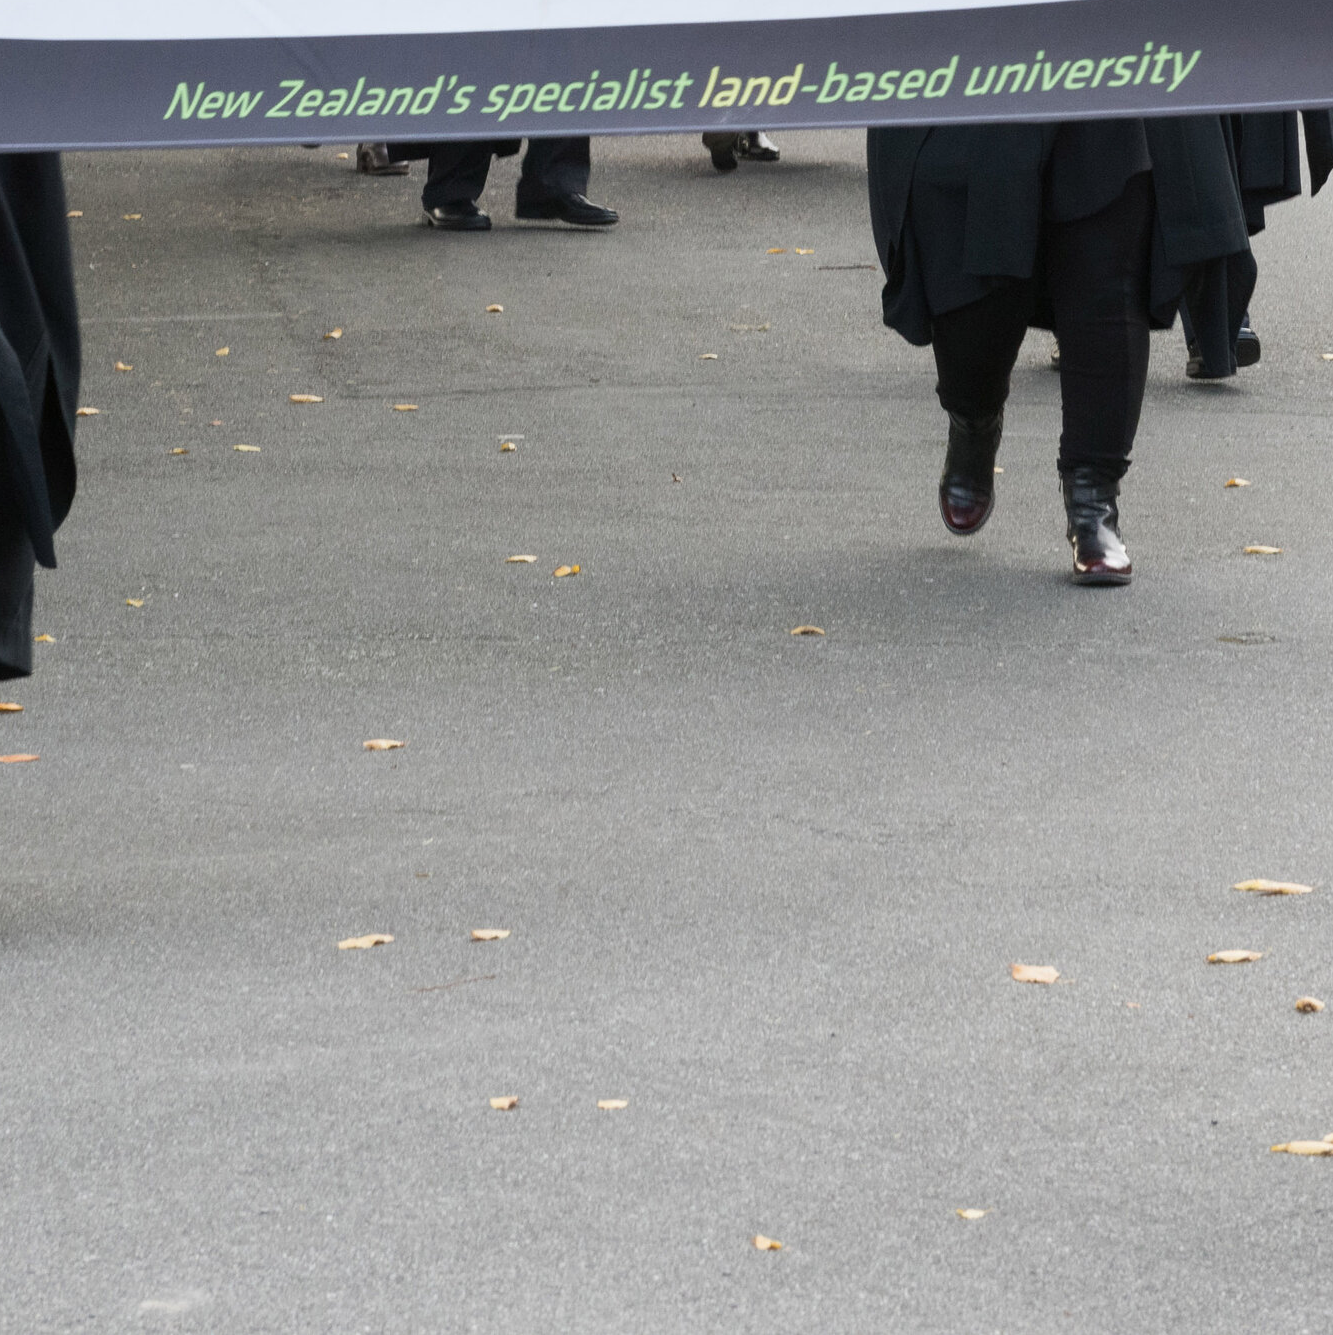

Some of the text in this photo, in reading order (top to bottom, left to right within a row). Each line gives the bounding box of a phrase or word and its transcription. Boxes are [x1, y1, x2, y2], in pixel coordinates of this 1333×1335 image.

[163, 81, 264, 121] New
[480, 68, 695, 123] specialist
[698, 54, 960, 109] land-based
[964, 41, 1202, 97] university
